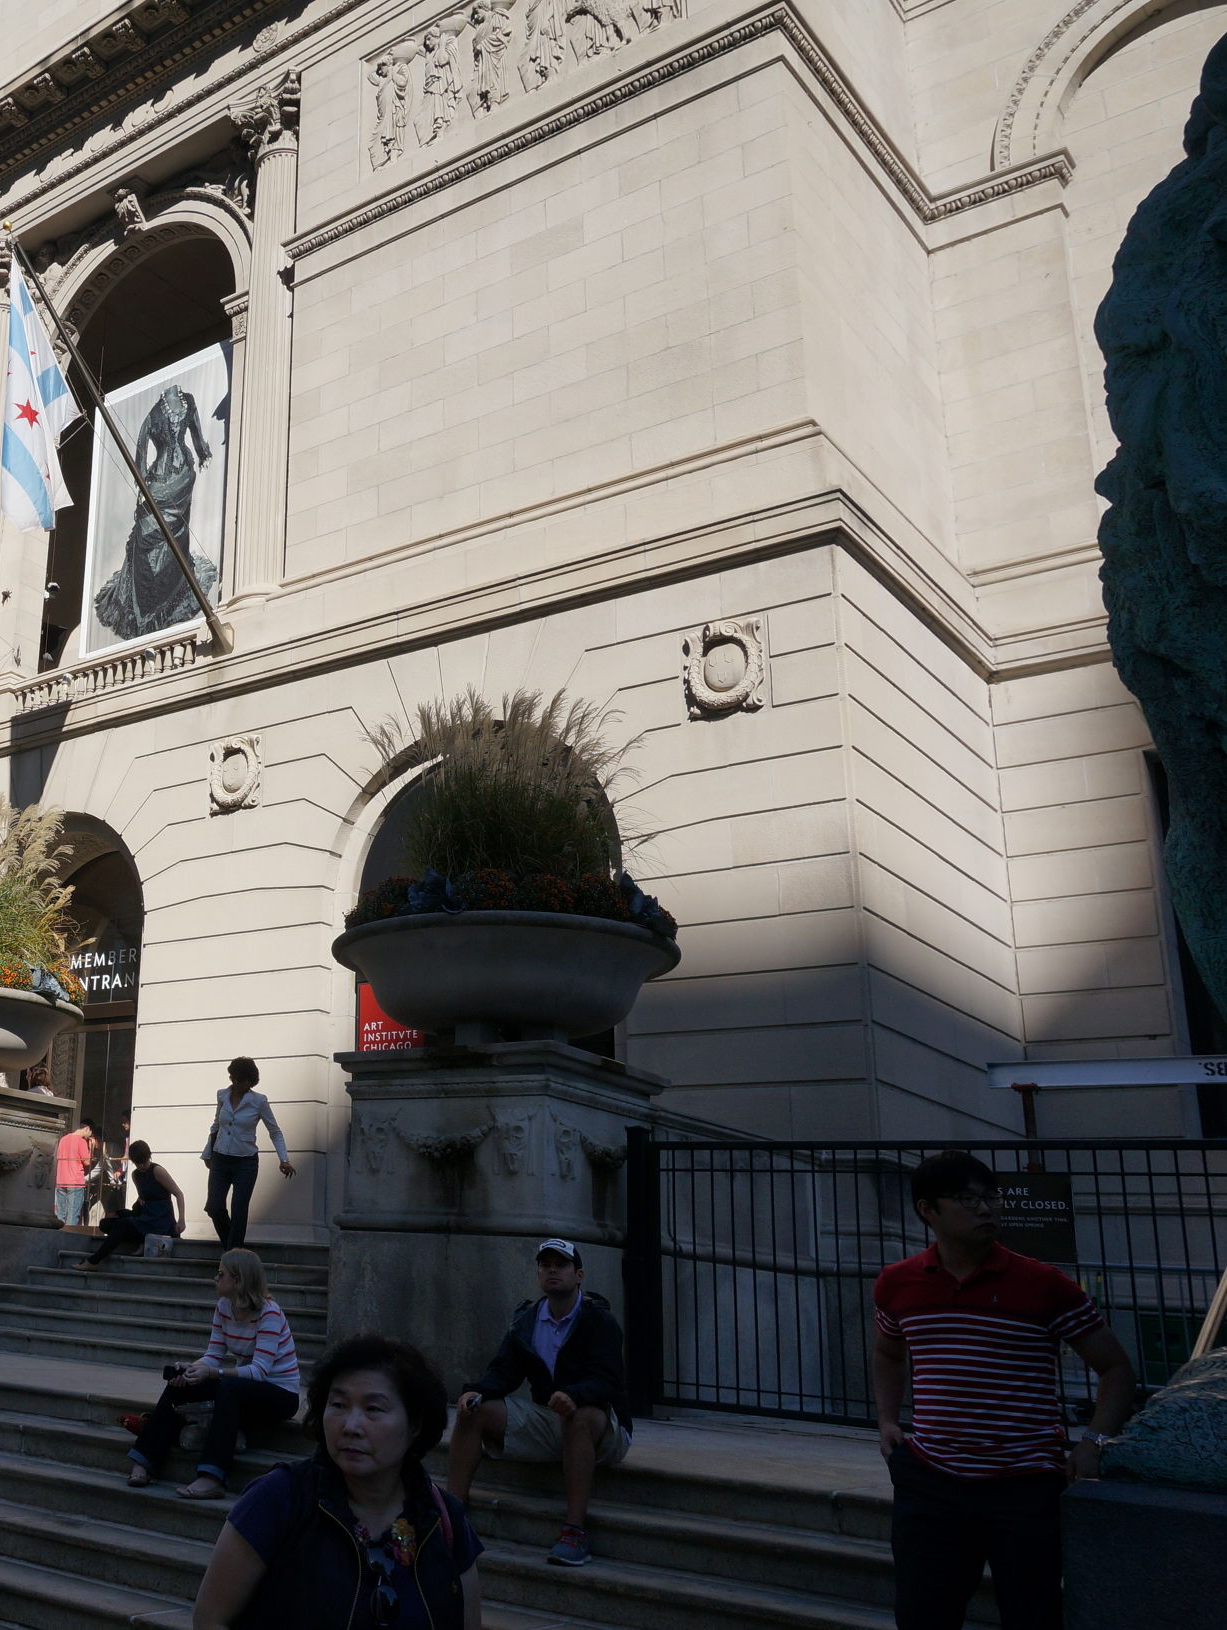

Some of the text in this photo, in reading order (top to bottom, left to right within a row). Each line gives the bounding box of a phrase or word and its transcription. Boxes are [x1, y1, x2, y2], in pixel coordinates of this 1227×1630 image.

[70, 948, 137, 970] MEMBER
[78, 972, 137, 992] NTRAN
[364, 1021, 384, 1031] ART
[363, 1029, 418, 1042] INSTITVTE
[363, 1041, 412, 1052] CHICAGO
[1007, 1187, 1030, 1196] ARE
[1020, 1201, 1070, 1210] CLOSED.
